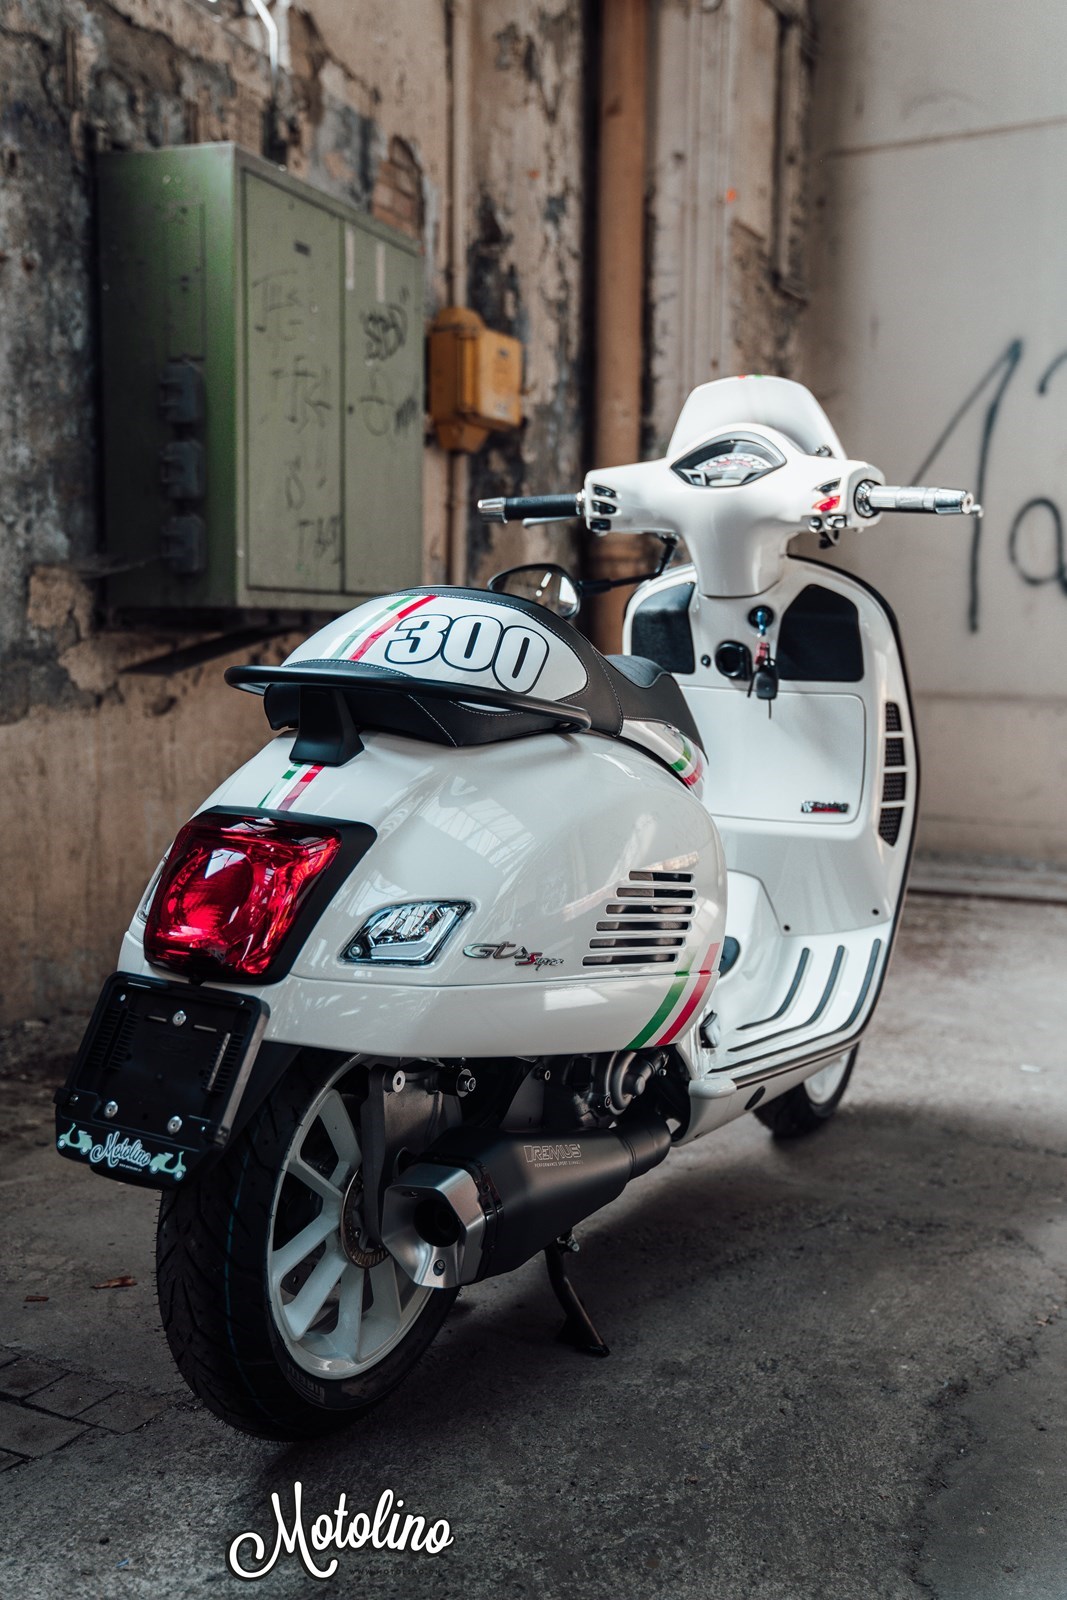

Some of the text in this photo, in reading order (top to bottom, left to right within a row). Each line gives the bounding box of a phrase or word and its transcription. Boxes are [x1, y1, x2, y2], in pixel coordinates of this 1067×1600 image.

[384, 613, 549, 695] 300
[90, 1131, 151, 1168] Motolino
[524, 1144, 582, 1162] REMUS
